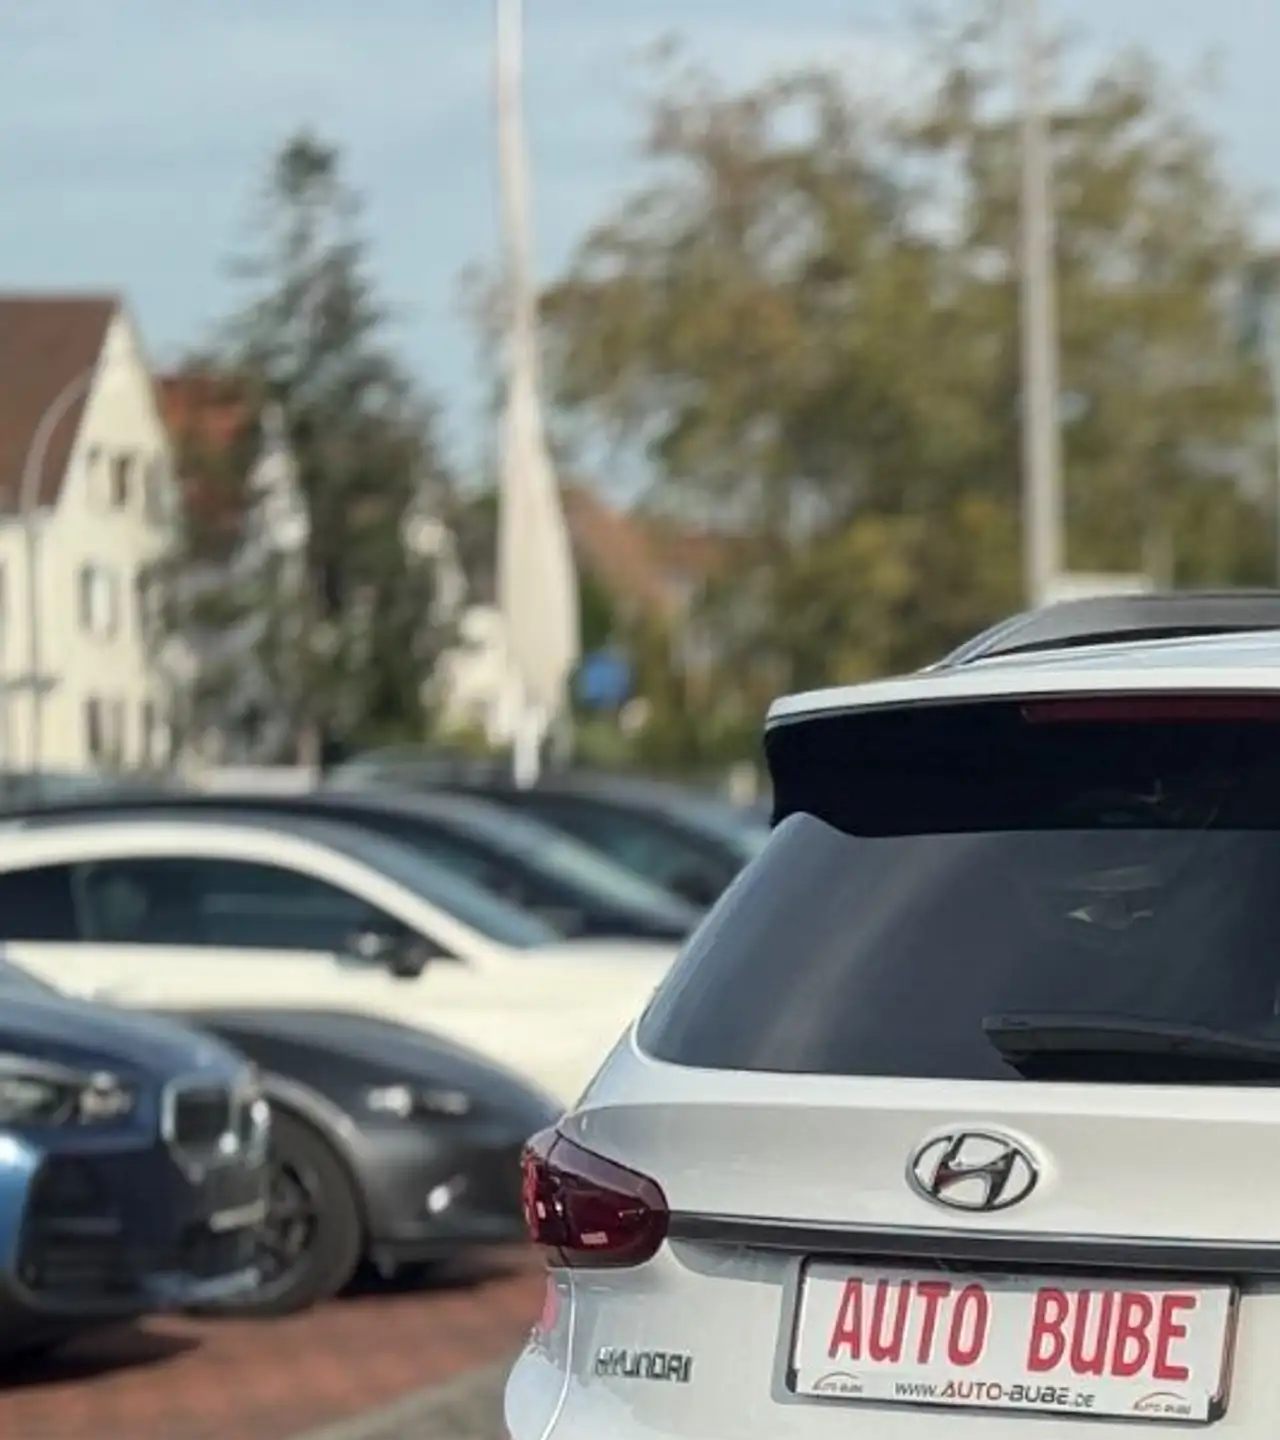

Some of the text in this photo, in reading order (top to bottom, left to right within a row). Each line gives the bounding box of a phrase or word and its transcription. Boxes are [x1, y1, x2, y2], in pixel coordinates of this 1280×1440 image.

[595, 1346, 692, 1382] HYUNDAI
[828, 1277, 1197, 1381] AUTO BUBE
